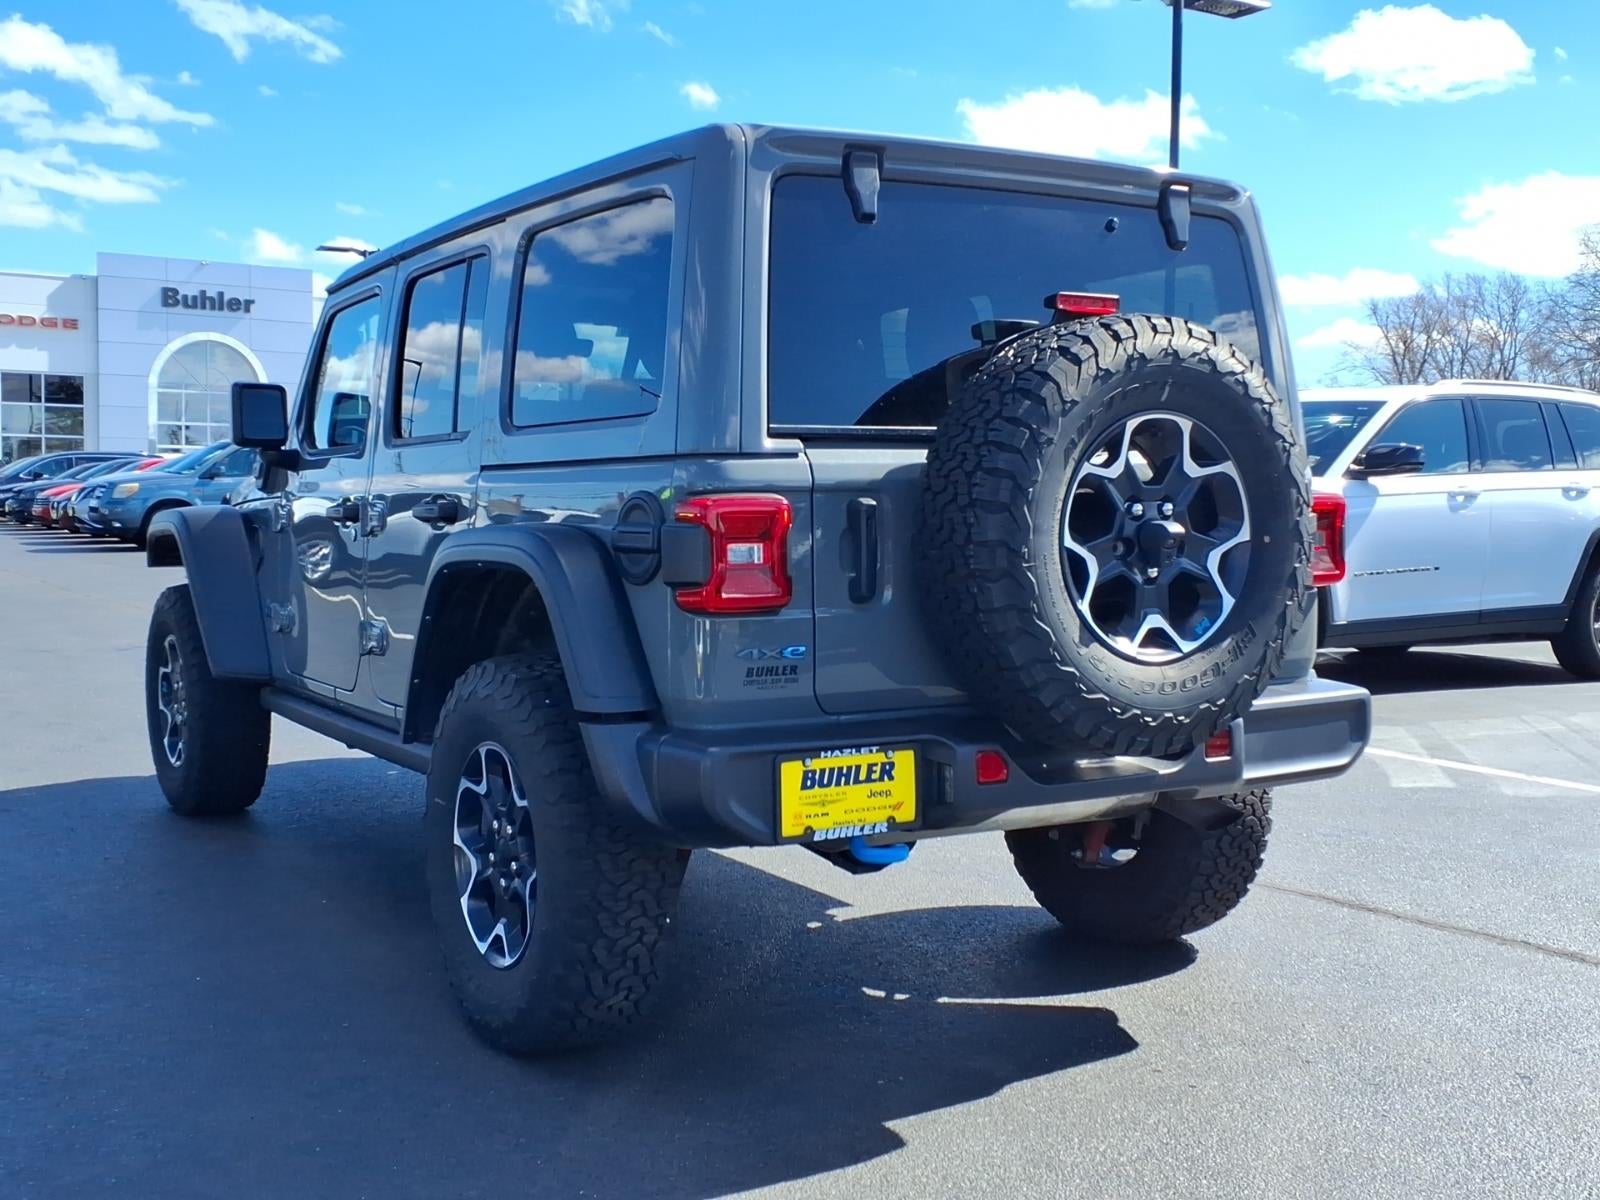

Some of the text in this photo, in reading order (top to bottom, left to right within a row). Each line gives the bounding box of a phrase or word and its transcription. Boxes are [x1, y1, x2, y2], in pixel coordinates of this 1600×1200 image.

[161, 286, 255, 314] Buhler
[0, 314, 79, 330] ODGE
[745, 664, 799, 679] BUHLER
[820, 745, 880, 759] HAZLET
[800, 760, 896, 791] BUHLER
[866, 788, 892, 799] Jeep
[813, 822, 889, 841] BUHLER
